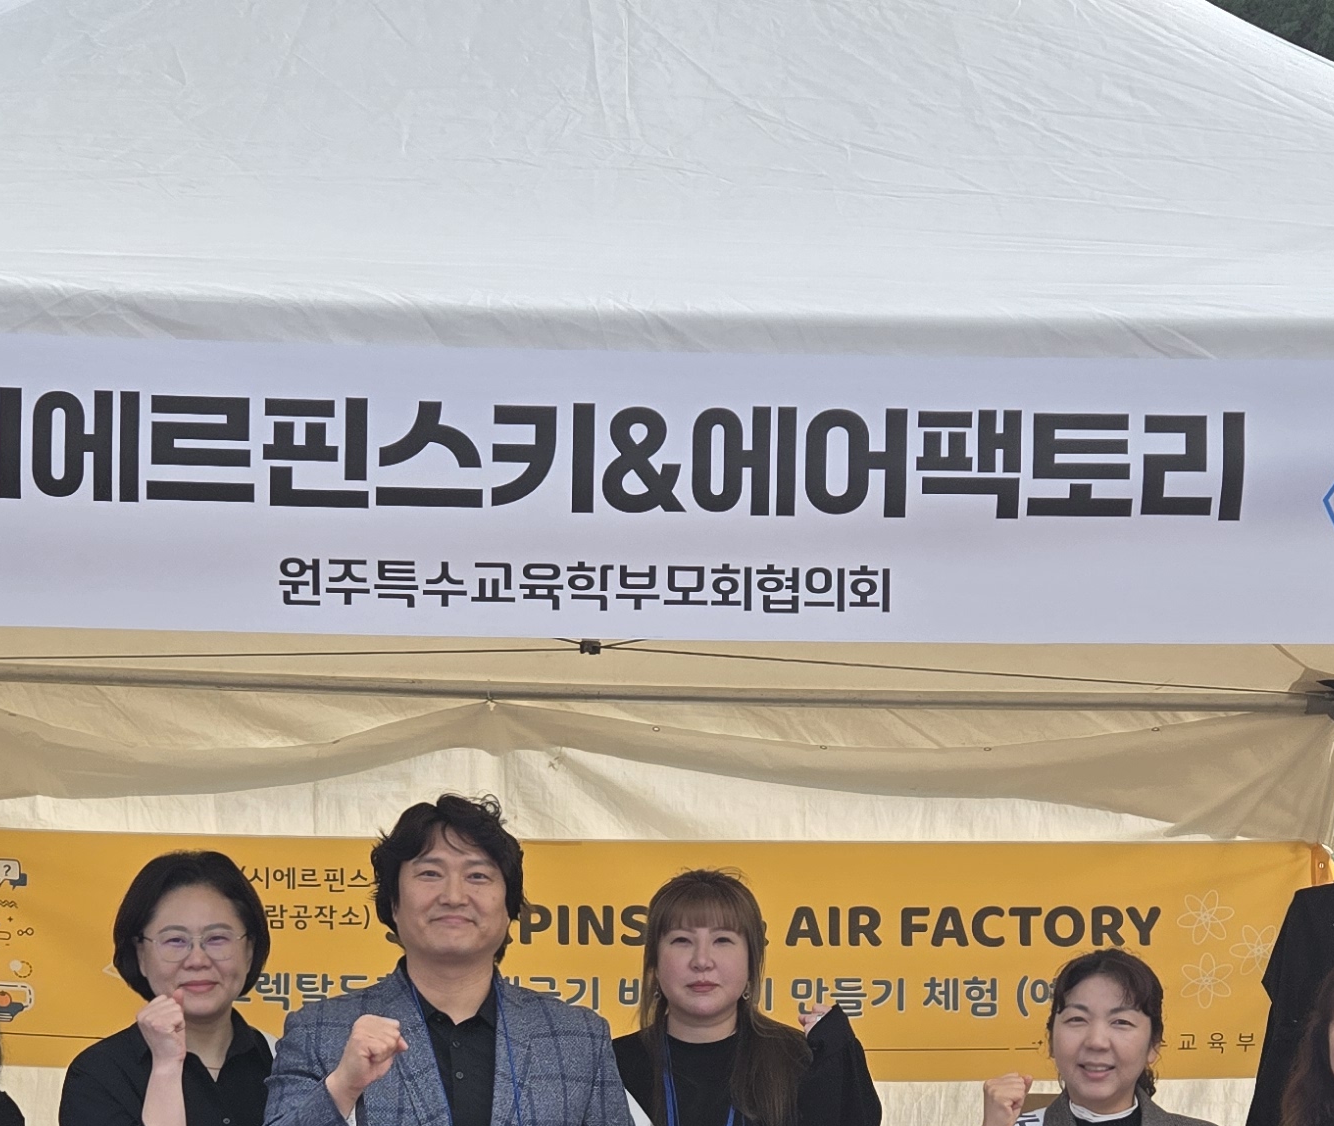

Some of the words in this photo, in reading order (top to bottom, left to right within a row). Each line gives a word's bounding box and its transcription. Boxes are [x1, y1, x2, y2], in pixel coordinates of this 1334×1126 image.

[277, 556, 892, 614] 원주특수교육학부모회협의회
[784, 905, 882, 947] AIR
[900, 905, 1162, 948] FACTORY
[923, 976, 998, 1018] 체험
